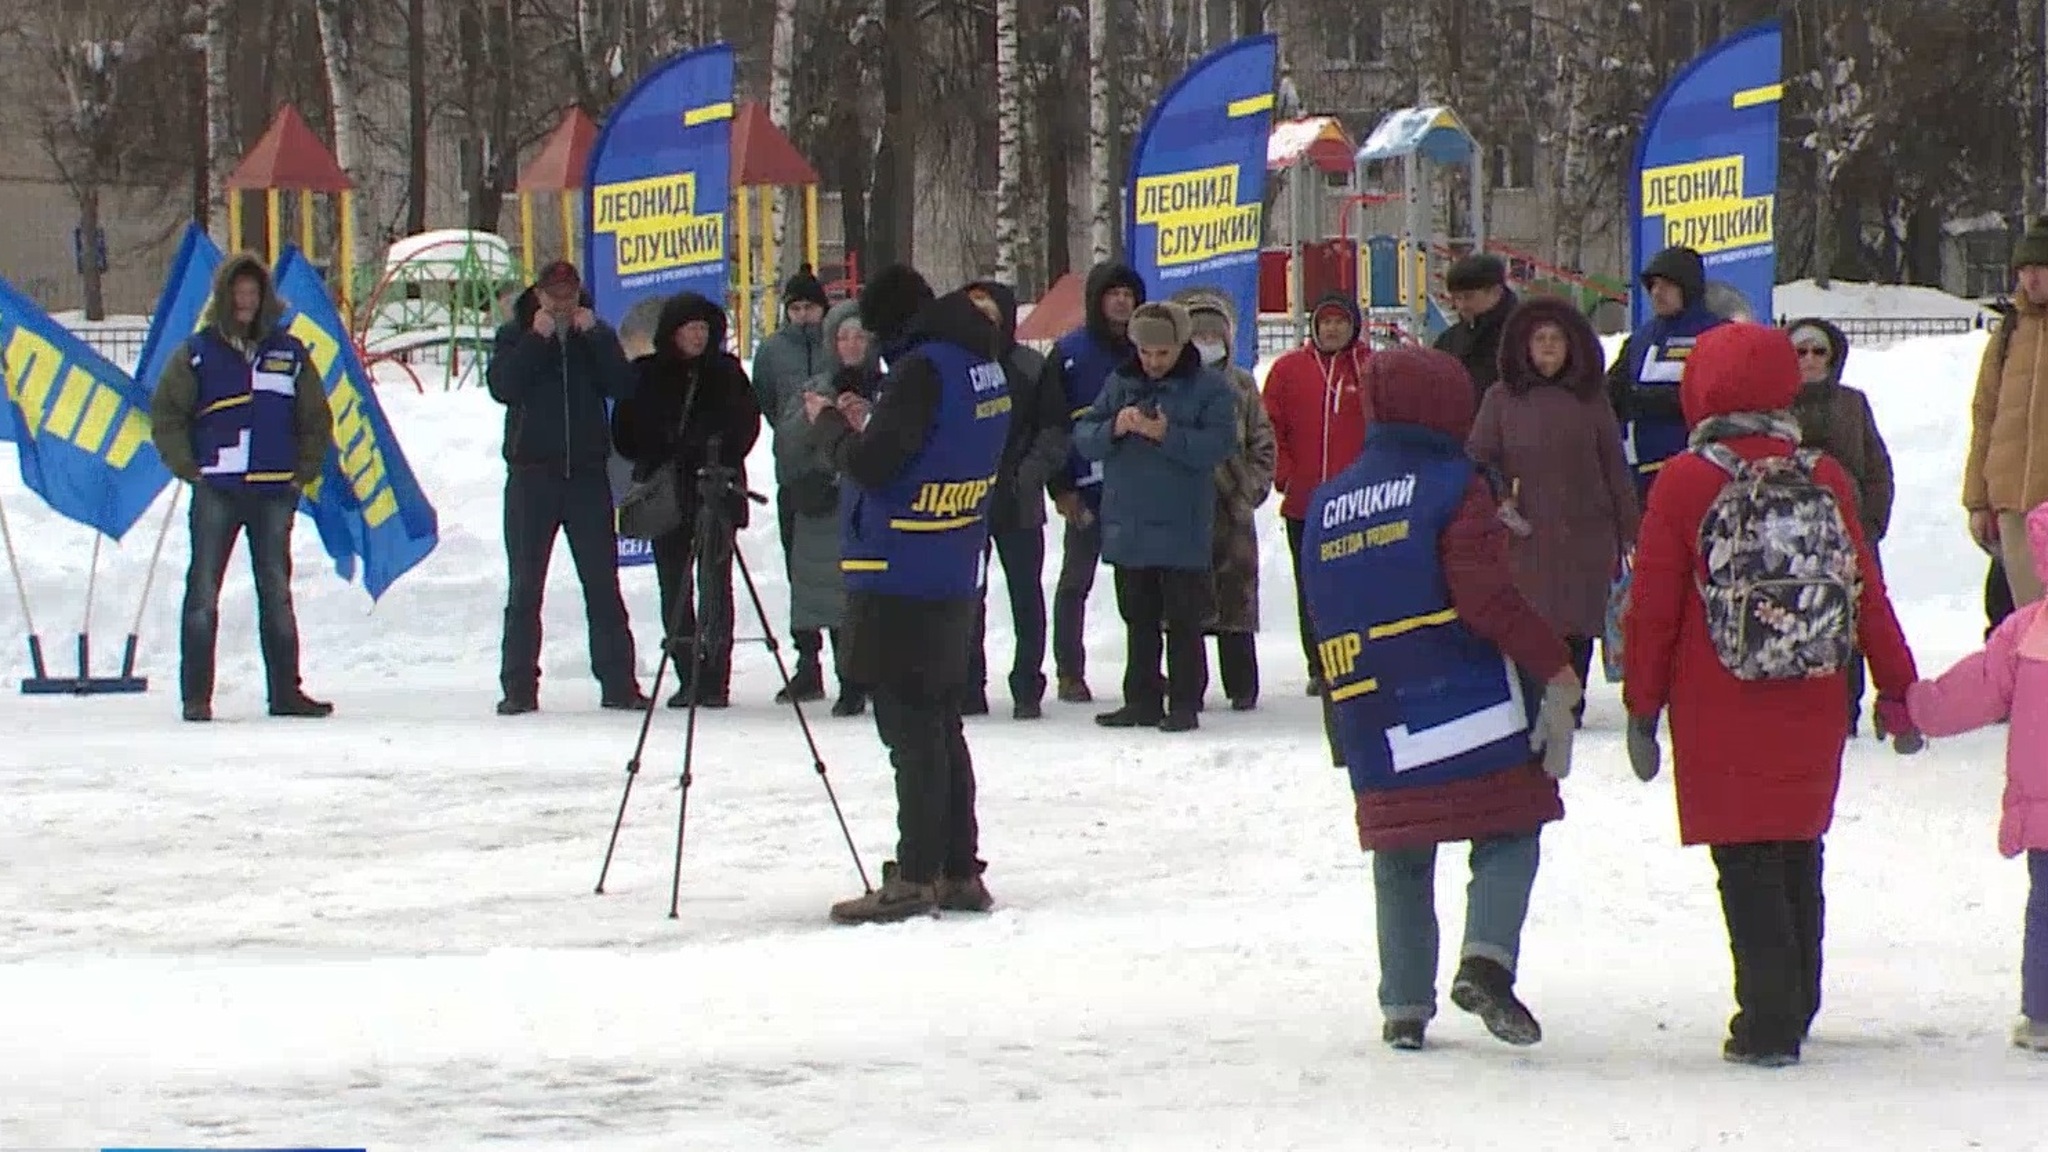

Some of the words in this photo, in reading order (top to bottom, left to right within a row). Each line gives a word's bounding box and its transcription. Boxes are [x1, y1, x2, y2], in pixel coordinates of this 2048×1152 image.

[598, 182, 689, 224] ЛЕОНИД
[1140, 174, 1234, 217] ЛЕОНИД
[1646, 165, 1738, 209] ЛЕОНИД
[619, 217, 719, 266] СЛУЦКИЙ
[1160, 206, 1259, 258] СЛУЦКИЙ
[1667, 200, 1768, 249] СЛУЦКИЙ
[911, 480, 988, 518] ЛДПР
[1322, 472, 1416, 530] СЛУЦКИЙ
